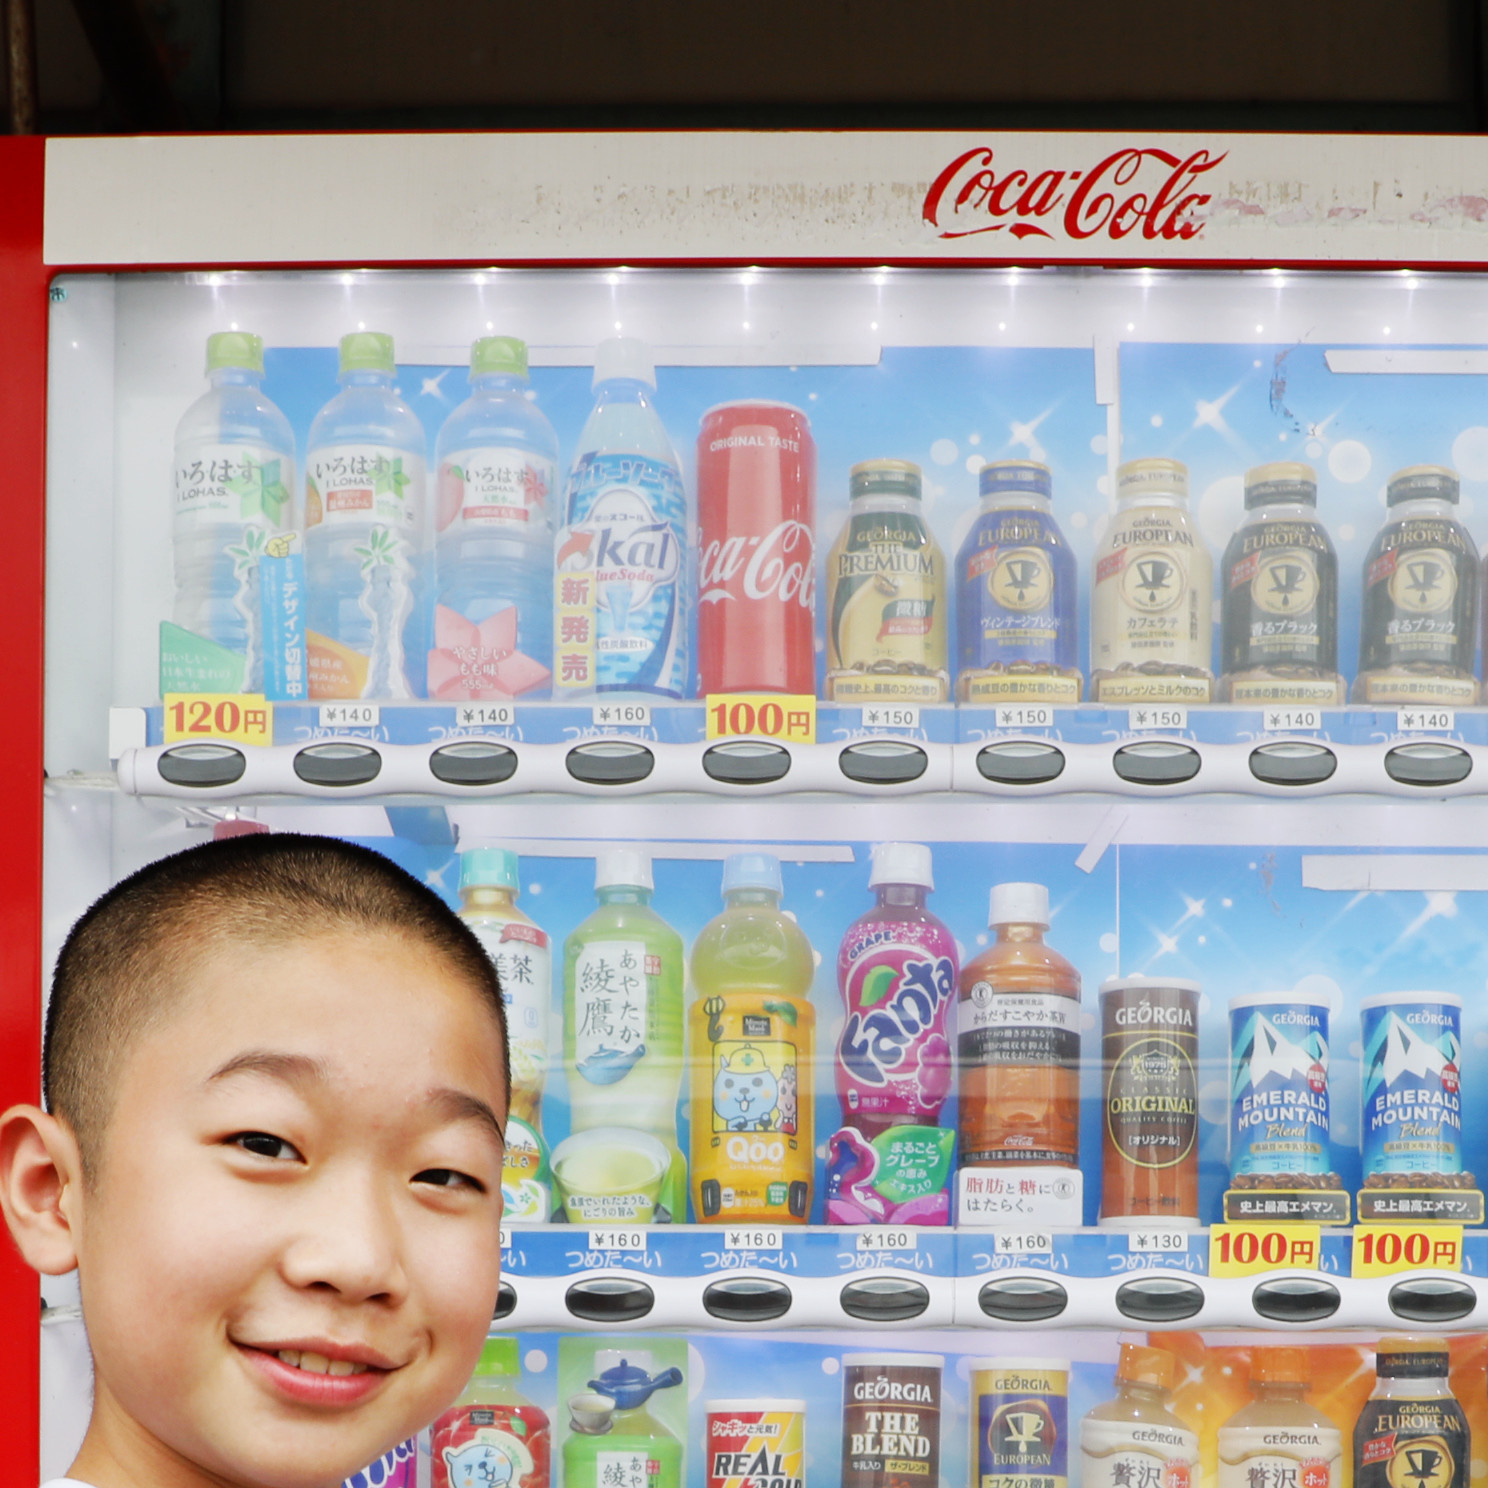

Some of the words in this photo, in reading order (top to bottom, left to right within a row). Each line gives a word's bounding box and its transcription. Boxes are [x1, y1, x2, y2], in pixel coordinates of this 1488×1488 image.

[922, 146, 1229, 241] Coca-Cola
[710, 437, 765, 451] ORIGINAL
[561, 578, 589, 682] 新発売
[169, 701, 267, 733] 120円
[326, 709, 372, 722] ¥140
[463, 709, 508, 723] ¥140
[600, 707, 646, 720] ¥160
[711, 703, 810, 737] 100円
[868, 710, 913, 724] ¥150
[1002, 710, 1047, 723] ¥150
[1136, 712, 1182, 725] ¥150
[1270, 713, 1315, 726] ¥140
[1404, 714, 1449, 727] ¥140
[848, 931, 893, 960] GRAPE
[580, 958, 618, 1038] 綾鷹
[619, 949, 641, 1043] あやたか
[840, 956, 956, 1085] Fanta
[1111, 1096, 1195, 1116] ORIGINAL
[1242, 1090, 1327, 1112] EMERALD
[1375, 1089, 1460, 1111] EMERALD
[1238, 1108, 1329, 1131] MOUNTAIN
[1371, 1107, 1461, 1131] MOUNTAIN
[1266, 1123, 1308, 1140] Blend
[726, 1136, 785, 1163] Qoo
[890, 1142, 937, 1156] まるごと
[886, 1155, 939, 1168] グレープ
[966, 1177, 1051, 1196] 脂肪と糖に
[967, 1199, 1035, 1214] はたらく。
[595, 1234, 641, 1247] ¥160
[730, 1233, 777, 1247] ¥160
[1214, 1232, 1314, 1264] 100円
[1357, 1233, 1457, 1265] 100円
[865, 1411, 920, 1434] THE
[850, 1433, 931, 1458] BLEND
[714, 1441, 787, 1476] REAL
